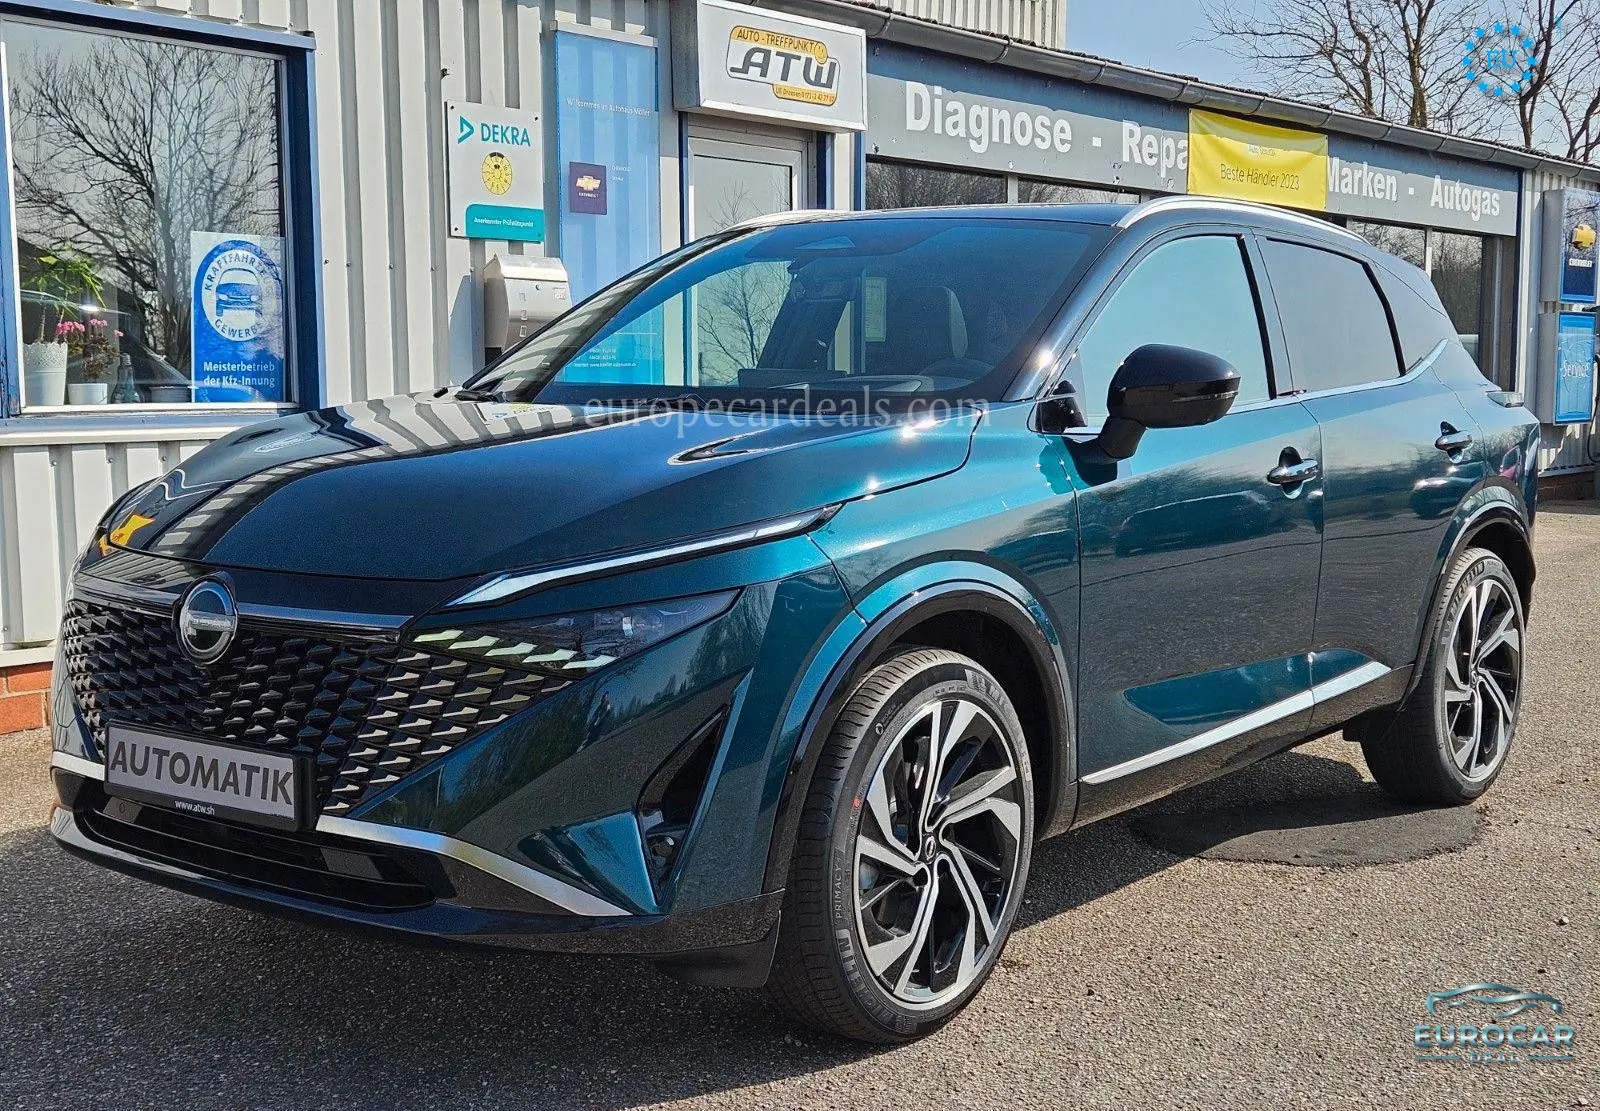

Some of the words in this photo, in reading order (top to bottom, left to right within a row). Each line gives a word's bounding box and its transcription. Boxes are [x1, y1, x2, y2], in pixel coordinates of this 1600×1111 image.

[737, 28, 760, 42] AUTO
[766, 34, 815, 52] TREFFPUNKT
[729, 47, 837, 90] ATW
[905, 81, 1073, 153] Diagnose
[480, 122, 531, 147] DEKRA
[1220, 163, 1245, 183] Beste
[1246, 167, 1279, 187] Händler
[1280, 172, 1300, 190] 2023
[1430, 175, 1500, 222] Autogas
[203, 361, 275, 372] Meisterbetrieb
[203, 376, 220, 387] der
[222, 376, 275, 388] Kfz-Innung
[110, 741, 293, 805] AUTOMATIK
[174, 800, 215, 816] www.atw.sh
[833, 866, 844, 919] PRIMACY
